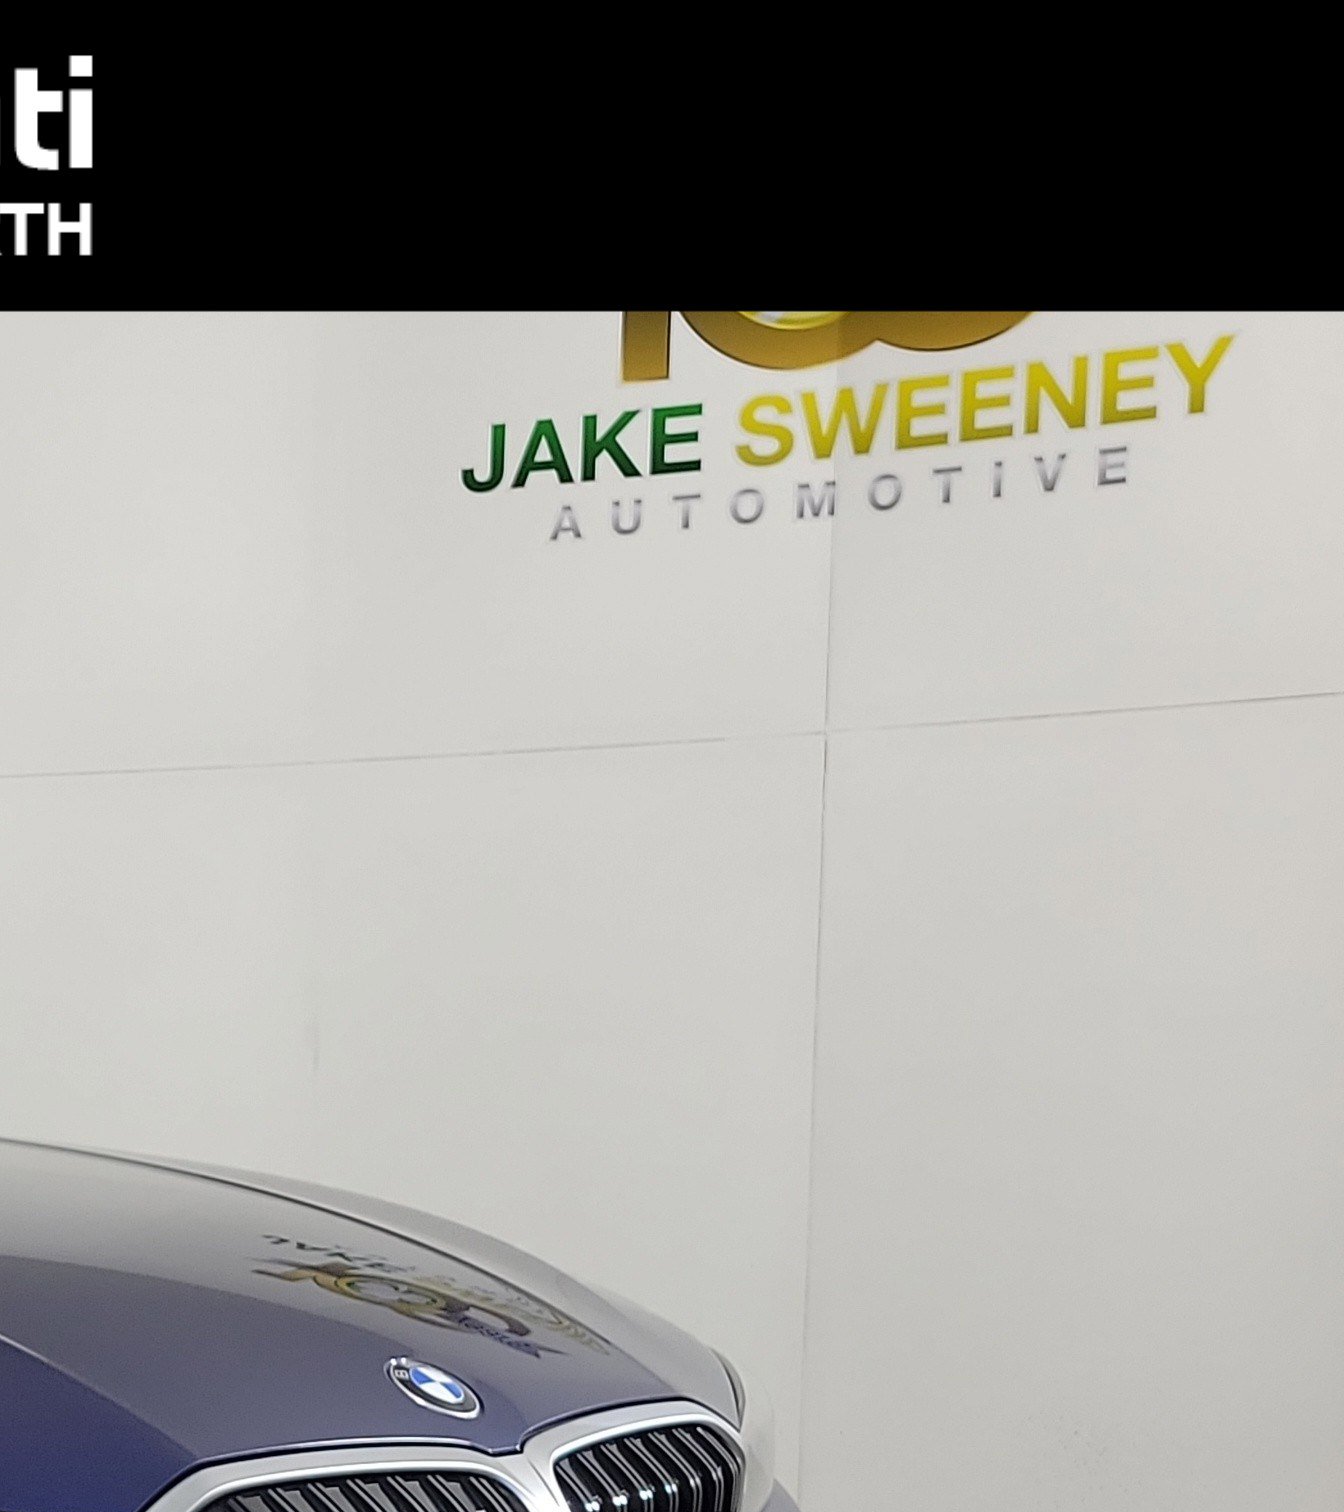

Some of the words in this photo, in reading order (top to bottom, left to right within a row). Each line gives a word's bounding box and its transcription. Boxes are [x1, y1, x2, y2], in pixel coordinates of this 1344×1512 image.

[461, 402, 703, 493] JAKE
[734, 334, 1235, 468] SWEENEY
[549, 446, 1129, 542] AUTOMOTIVE
